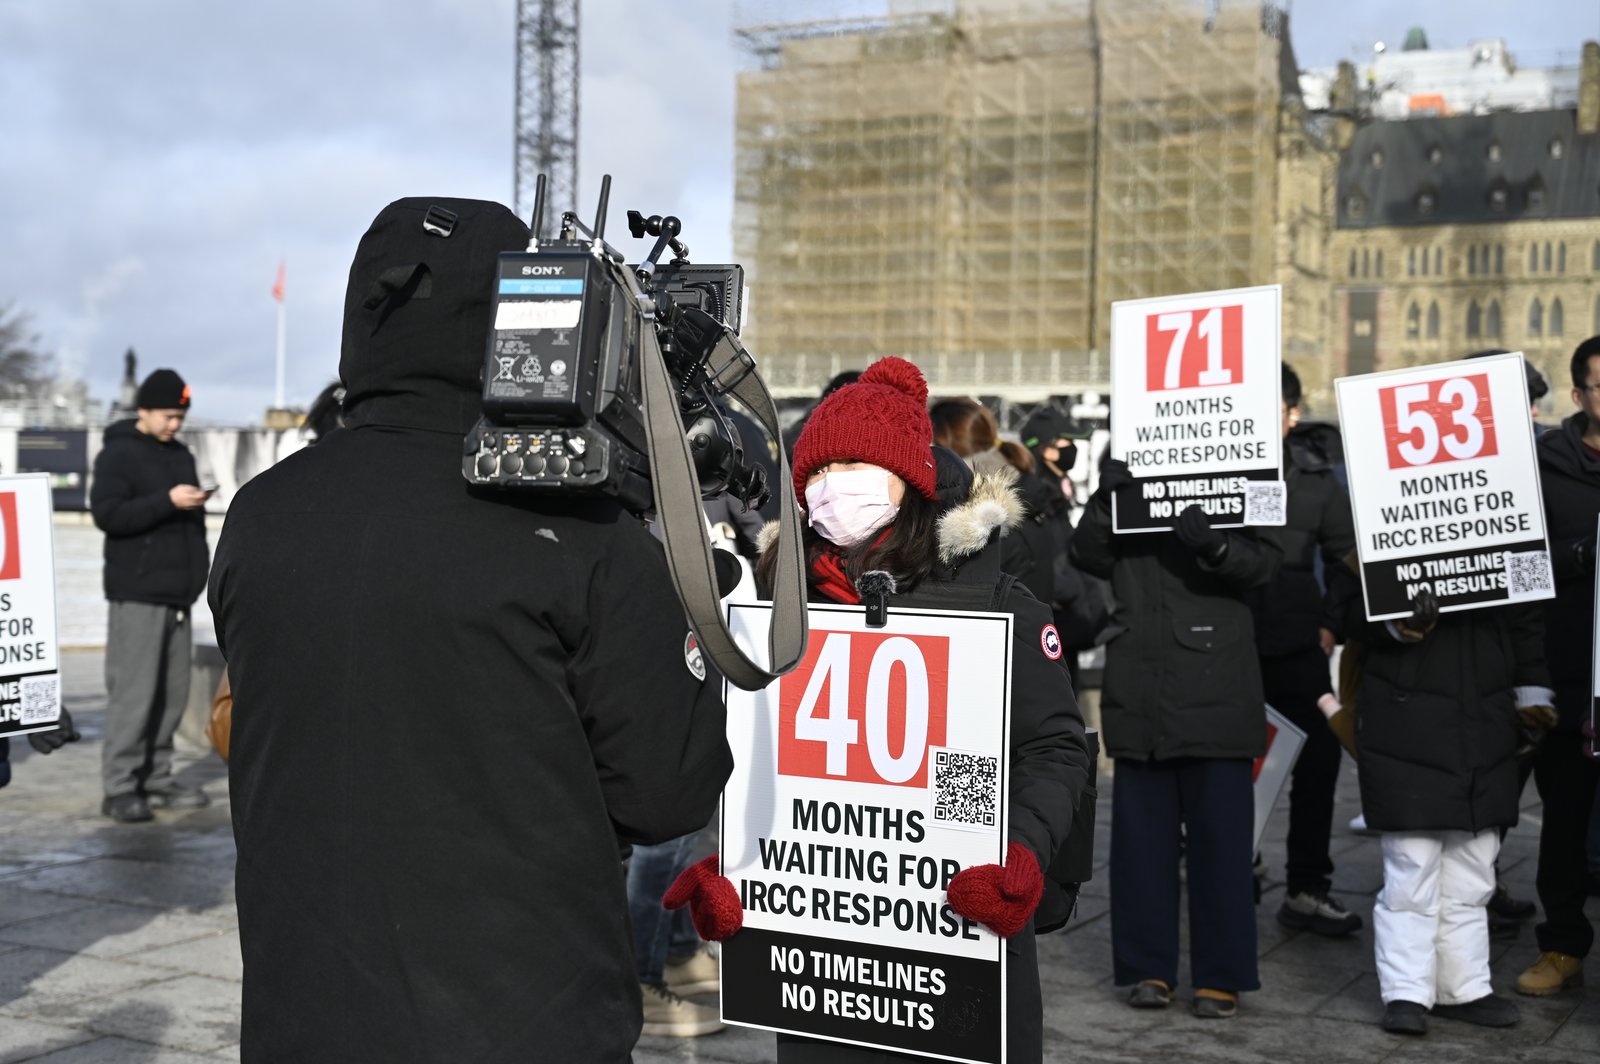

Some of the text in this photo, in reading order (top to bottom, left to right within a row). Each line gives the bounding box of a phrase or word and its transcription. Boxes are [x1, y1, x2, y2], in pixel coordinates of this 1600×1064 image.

[521, 266, 564, 276] SONY
[1157, 307, 1232, 390] 71
[1155, 396, 1233, 418] MONTHS
[1394, 377, 1485, 466] 53
[1136, 418, 1255, 443] WAITING FOR
[1126, 441, 1267, 467] IRCC RESPONSE
[1142, 481, 1166, 499] NO
[1400, 469, 1488, 497] MONTHS
[1150, 496, 1243, 518] NO RULTS
[1381, 490, 1515, 524] WAITING FOR
[1372, 513, 1531, 550] IRCC RESPONSE
[1396, 562, 1421, 581] NO
[1434, 572, 1508, 597] RESULTS
[795, 632, 930, 784] 40
[792, 798, 926, 843] MONTHS
[758, 838, 962, 891] WAITING FOR
[741, 879, 981, 941] IRCC RESPONSE
[770, 945, 947, 996] NO TIMELINES
[782, 981, 935, 1031] NO RESULTS
